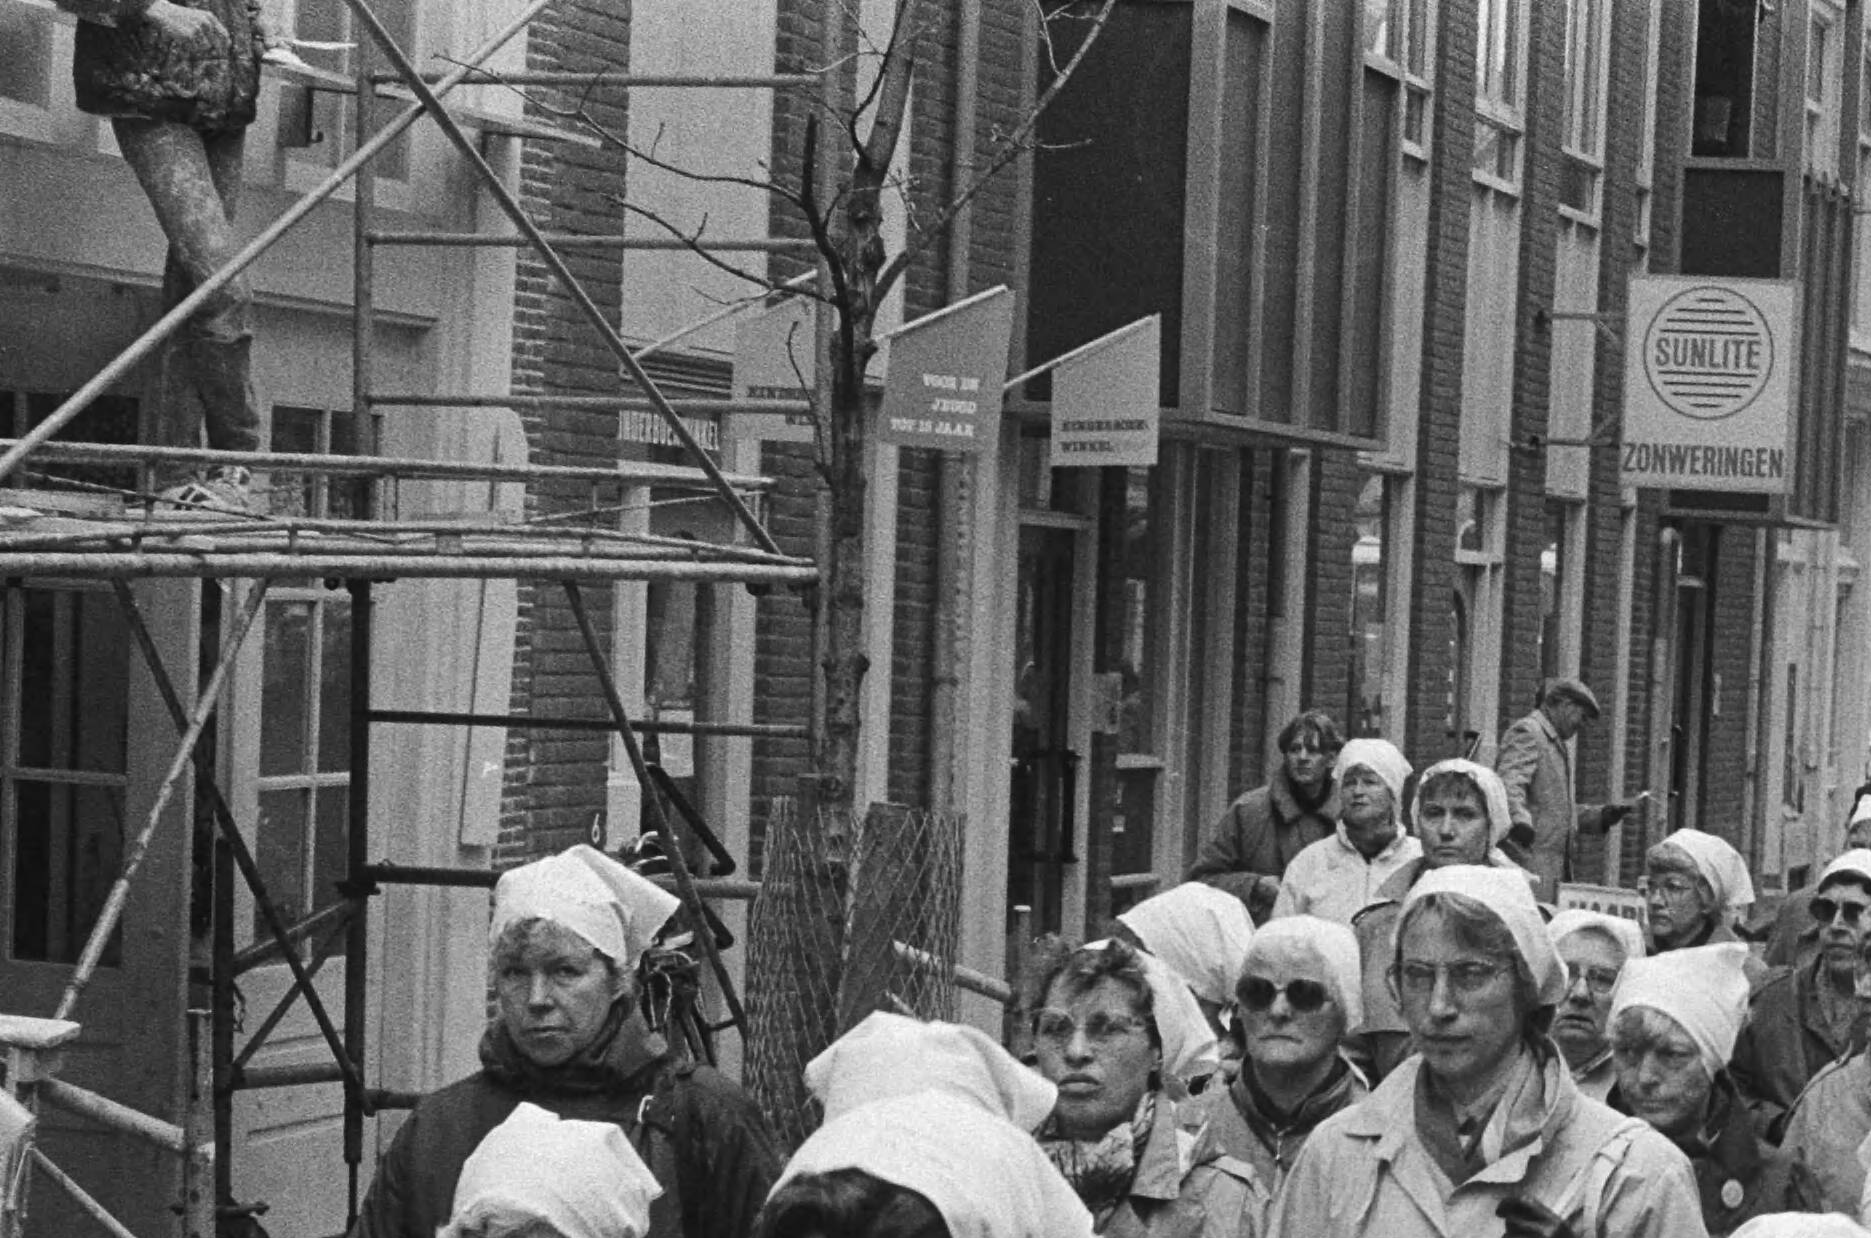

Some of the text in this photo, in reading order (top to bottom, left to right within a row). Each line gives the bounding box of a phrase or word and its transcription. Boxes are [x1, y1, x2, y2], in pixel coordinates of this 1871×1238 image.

[1655, 337, 1762, 369] SUNLITE
[935, 421, 975, 437] JAAR
[1622, 442, 1784, 478] ZONWERINGEN
[591, 813, 600, 844] 6
